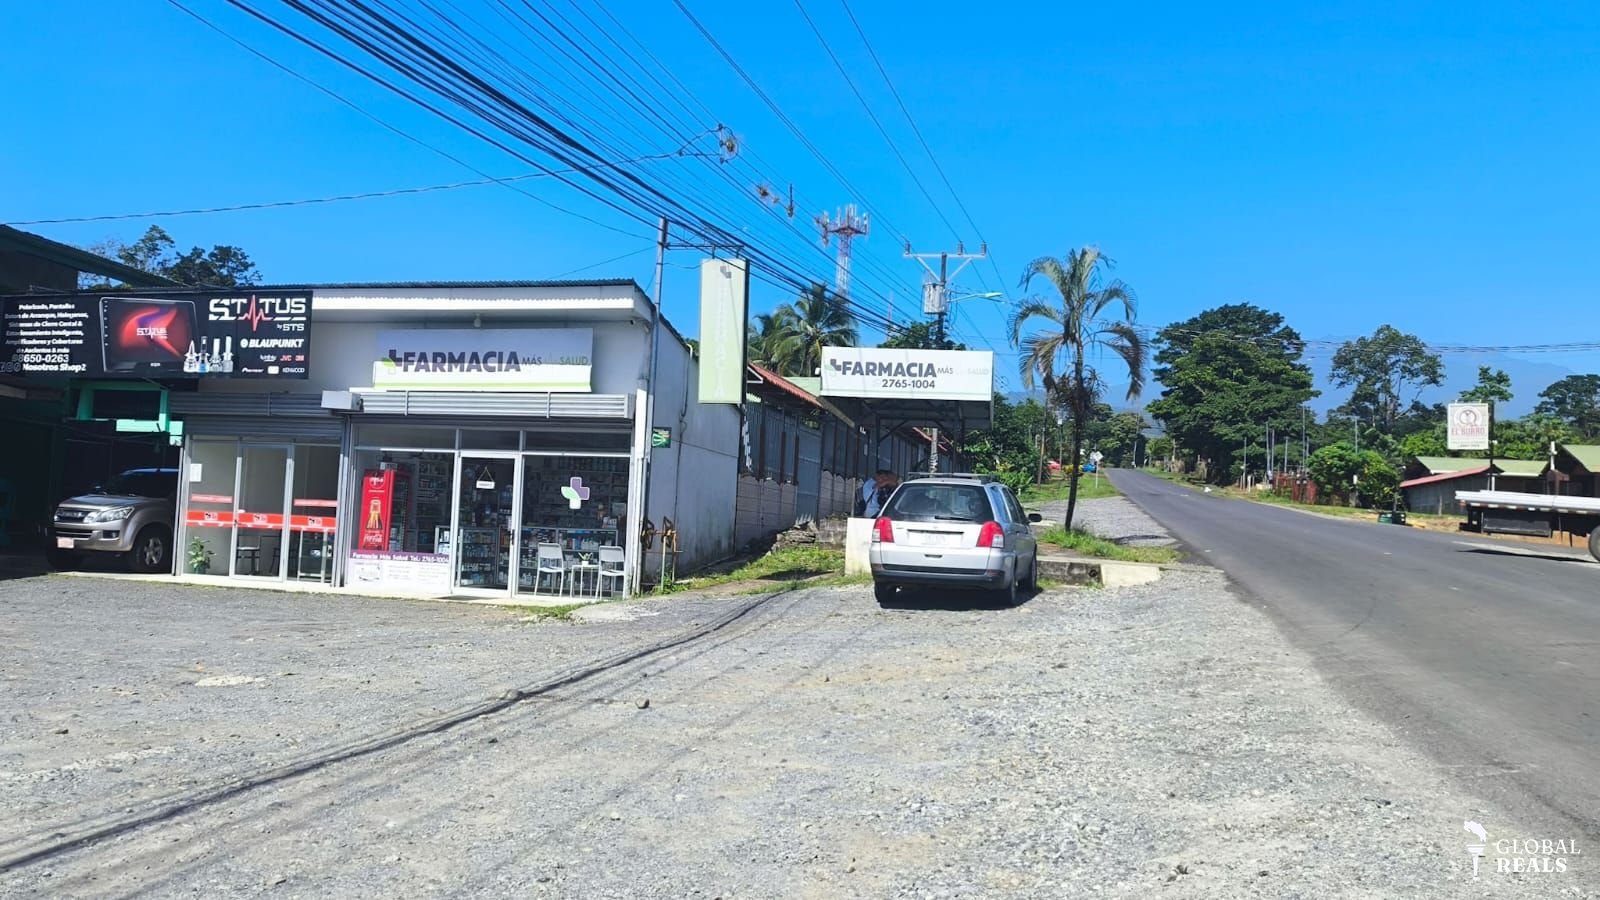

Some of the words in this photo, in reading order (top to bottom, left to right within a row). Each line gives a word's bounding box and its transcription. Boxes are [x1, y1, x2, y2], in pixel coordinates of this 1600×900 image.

[209, 296, 306, 321] STATUS
[282, 323, 305, 331] STS
[248, 338, 304, 348] BLAUPUNKT
[402, 351, 521, 373] FARMACIA
[521, 356, 542, 366] MÁS
[559, 356, 588, 366] SALUD
[841, 361, 937, 378] FARMACIA
[881, 379, 935, 389] 2765-1004
